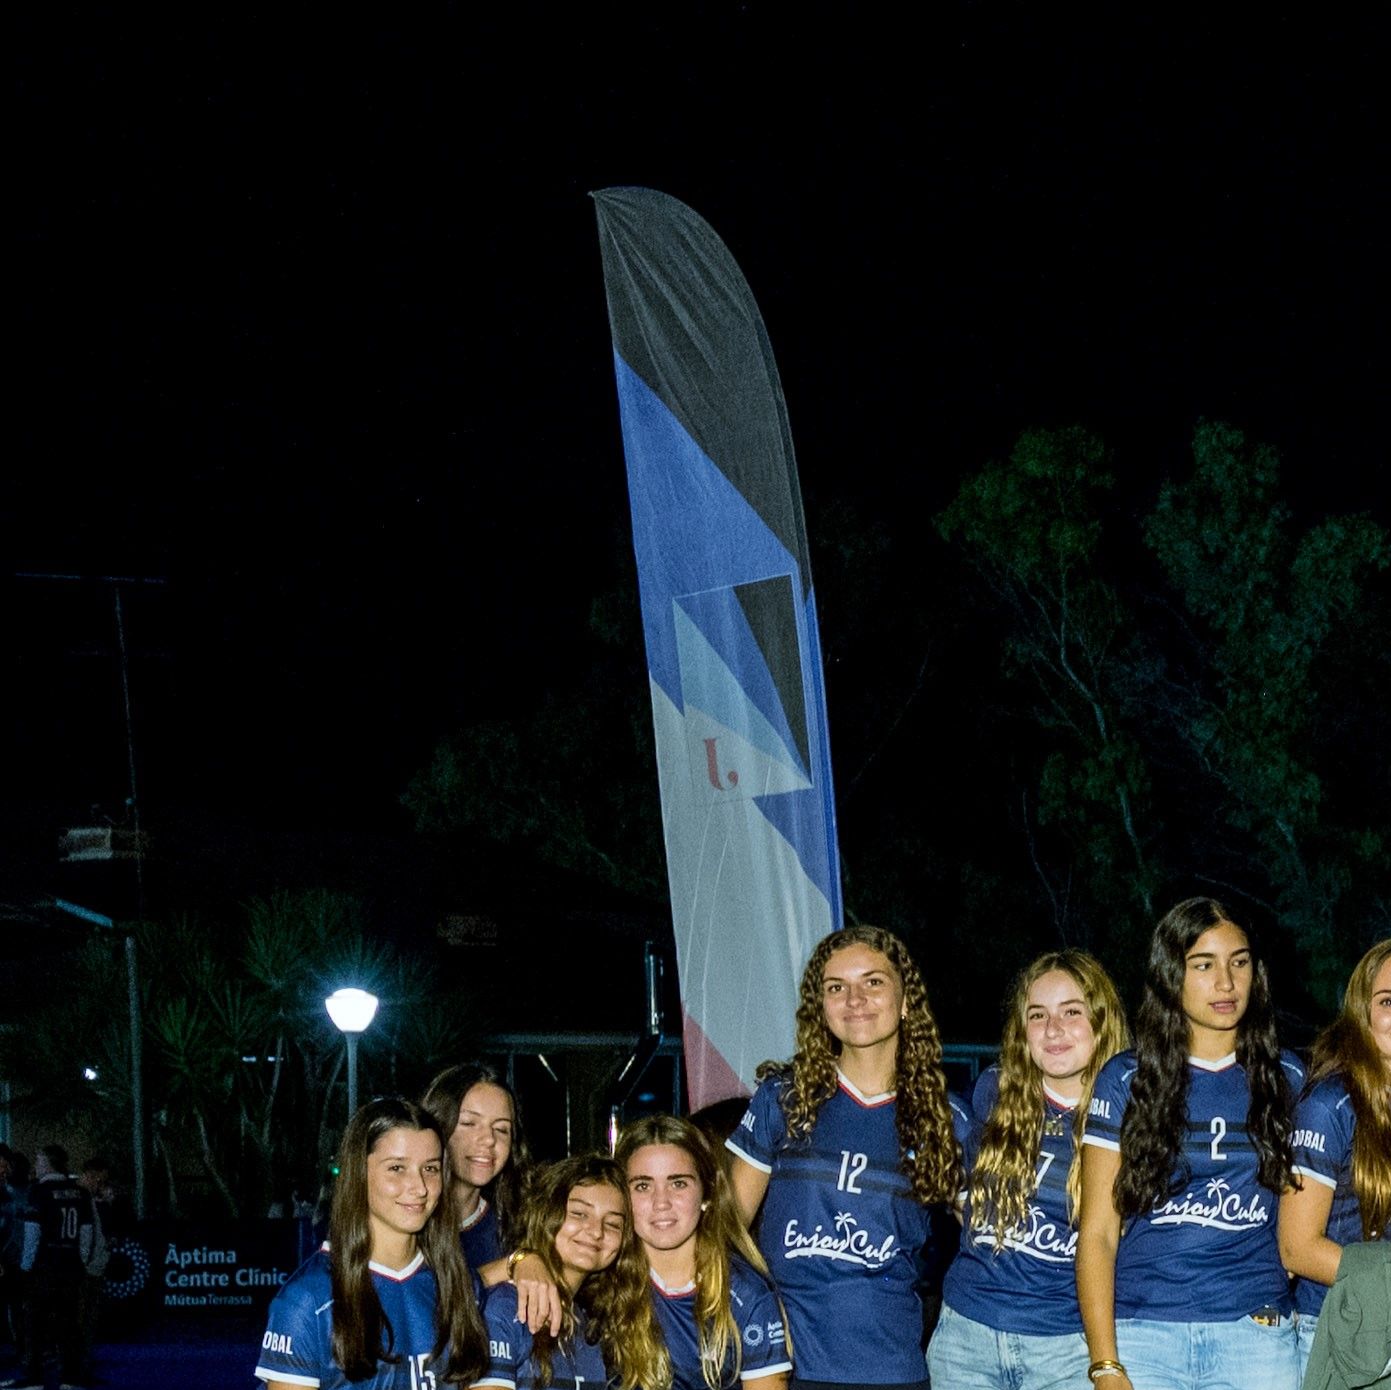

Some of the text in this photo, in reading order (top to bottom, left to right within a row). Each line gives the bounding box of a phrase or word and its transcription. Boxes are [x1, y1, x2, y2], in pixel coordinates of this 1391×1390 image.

[1210, 1117, 1227, 1161] 2
[837, 1150, 868, 1195] 12
[1153, 1192, 1268, 1225] njoy Cuba
[784, 1219, 848, 1256] Enjoy
[1035, 1223, 1079, 1256] Cub
[165, 1267, 288, 1288] Centre Clínic
[262, 1331, 294, 1355] OBAL
